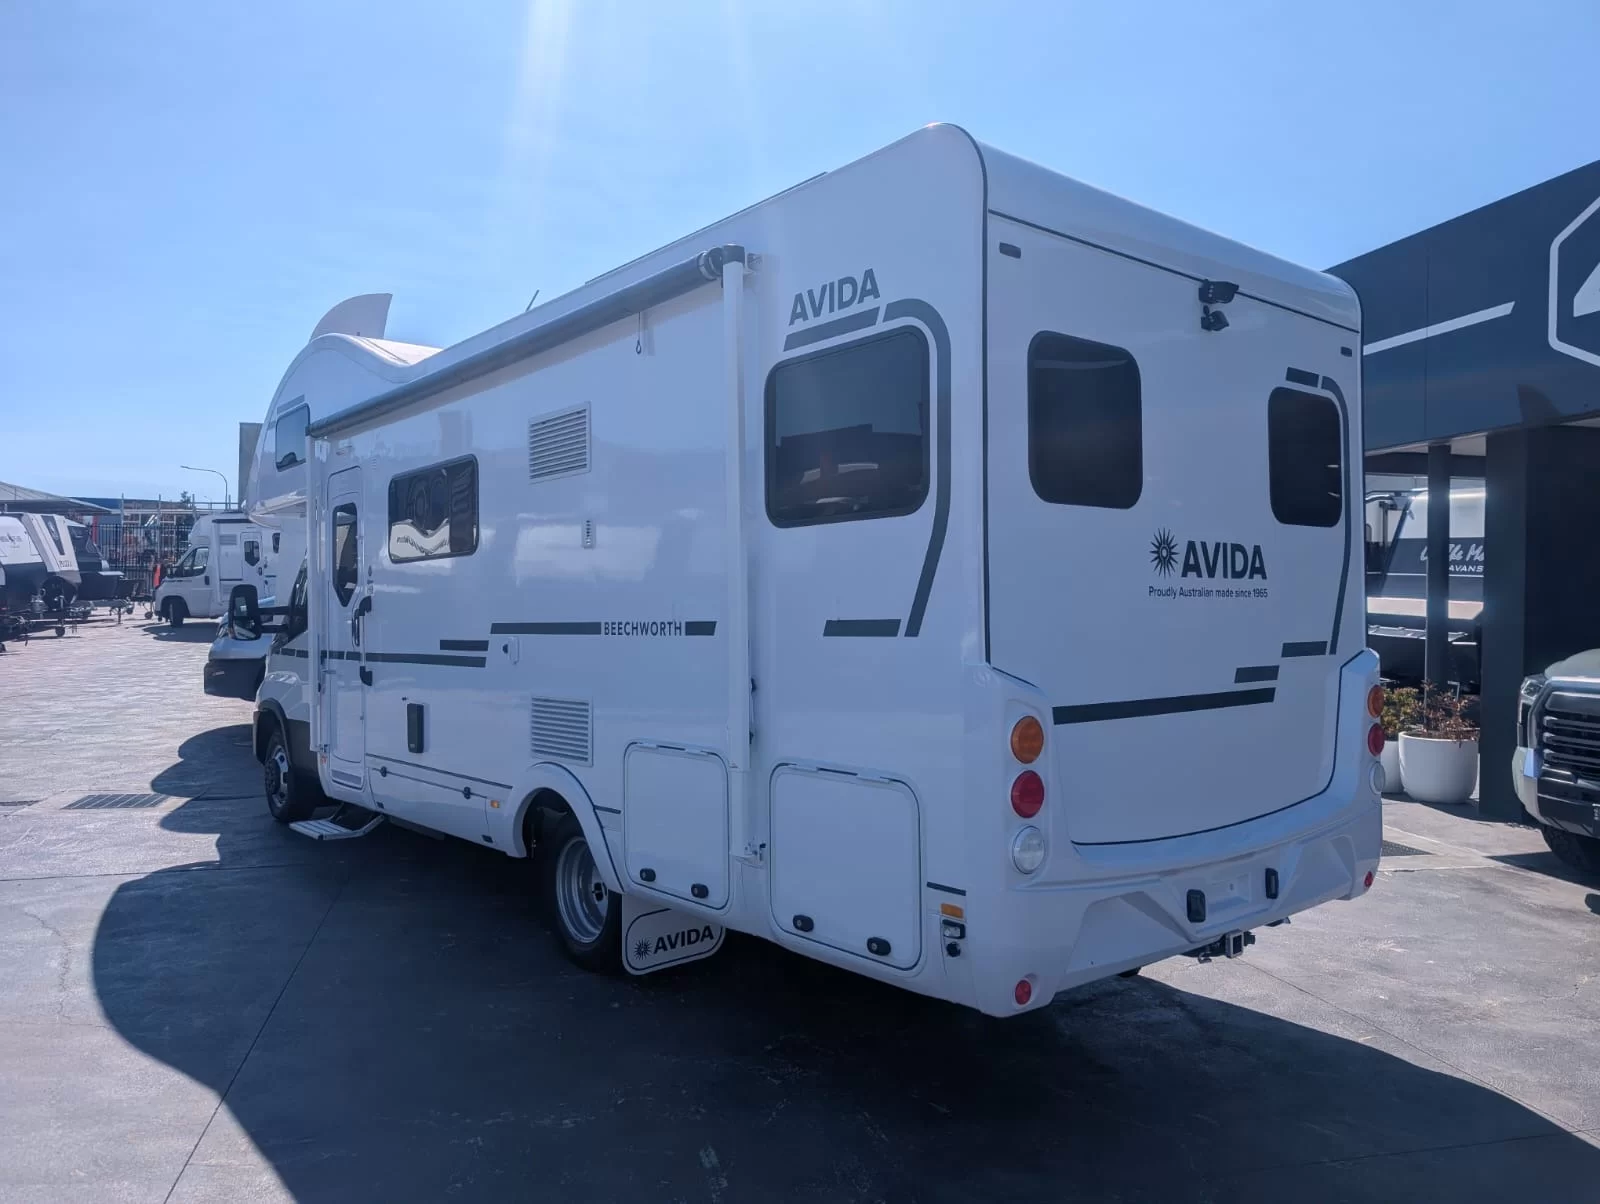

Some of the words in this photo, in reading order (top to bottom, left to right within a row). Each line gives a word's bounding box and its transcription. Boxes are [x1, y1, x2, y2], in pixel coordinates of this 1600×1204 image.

[788, 267, 880, 327] AVIDA
[1181, 540, 1268, 580] AVIDA
[1448, 564, 1484, 573] AVANS
[1149, 586, 1177, 600] Proudly
[1179, 587, 1214, 598] Australian
[1215, 588, 1234, 598] made
[1235, 588, 1252, 599] since
[1252, 588, 1268, 598] 1965
[604, 621, 682, 637] BEECHWORTH
[653, 925, 714, 955] AVIDA
